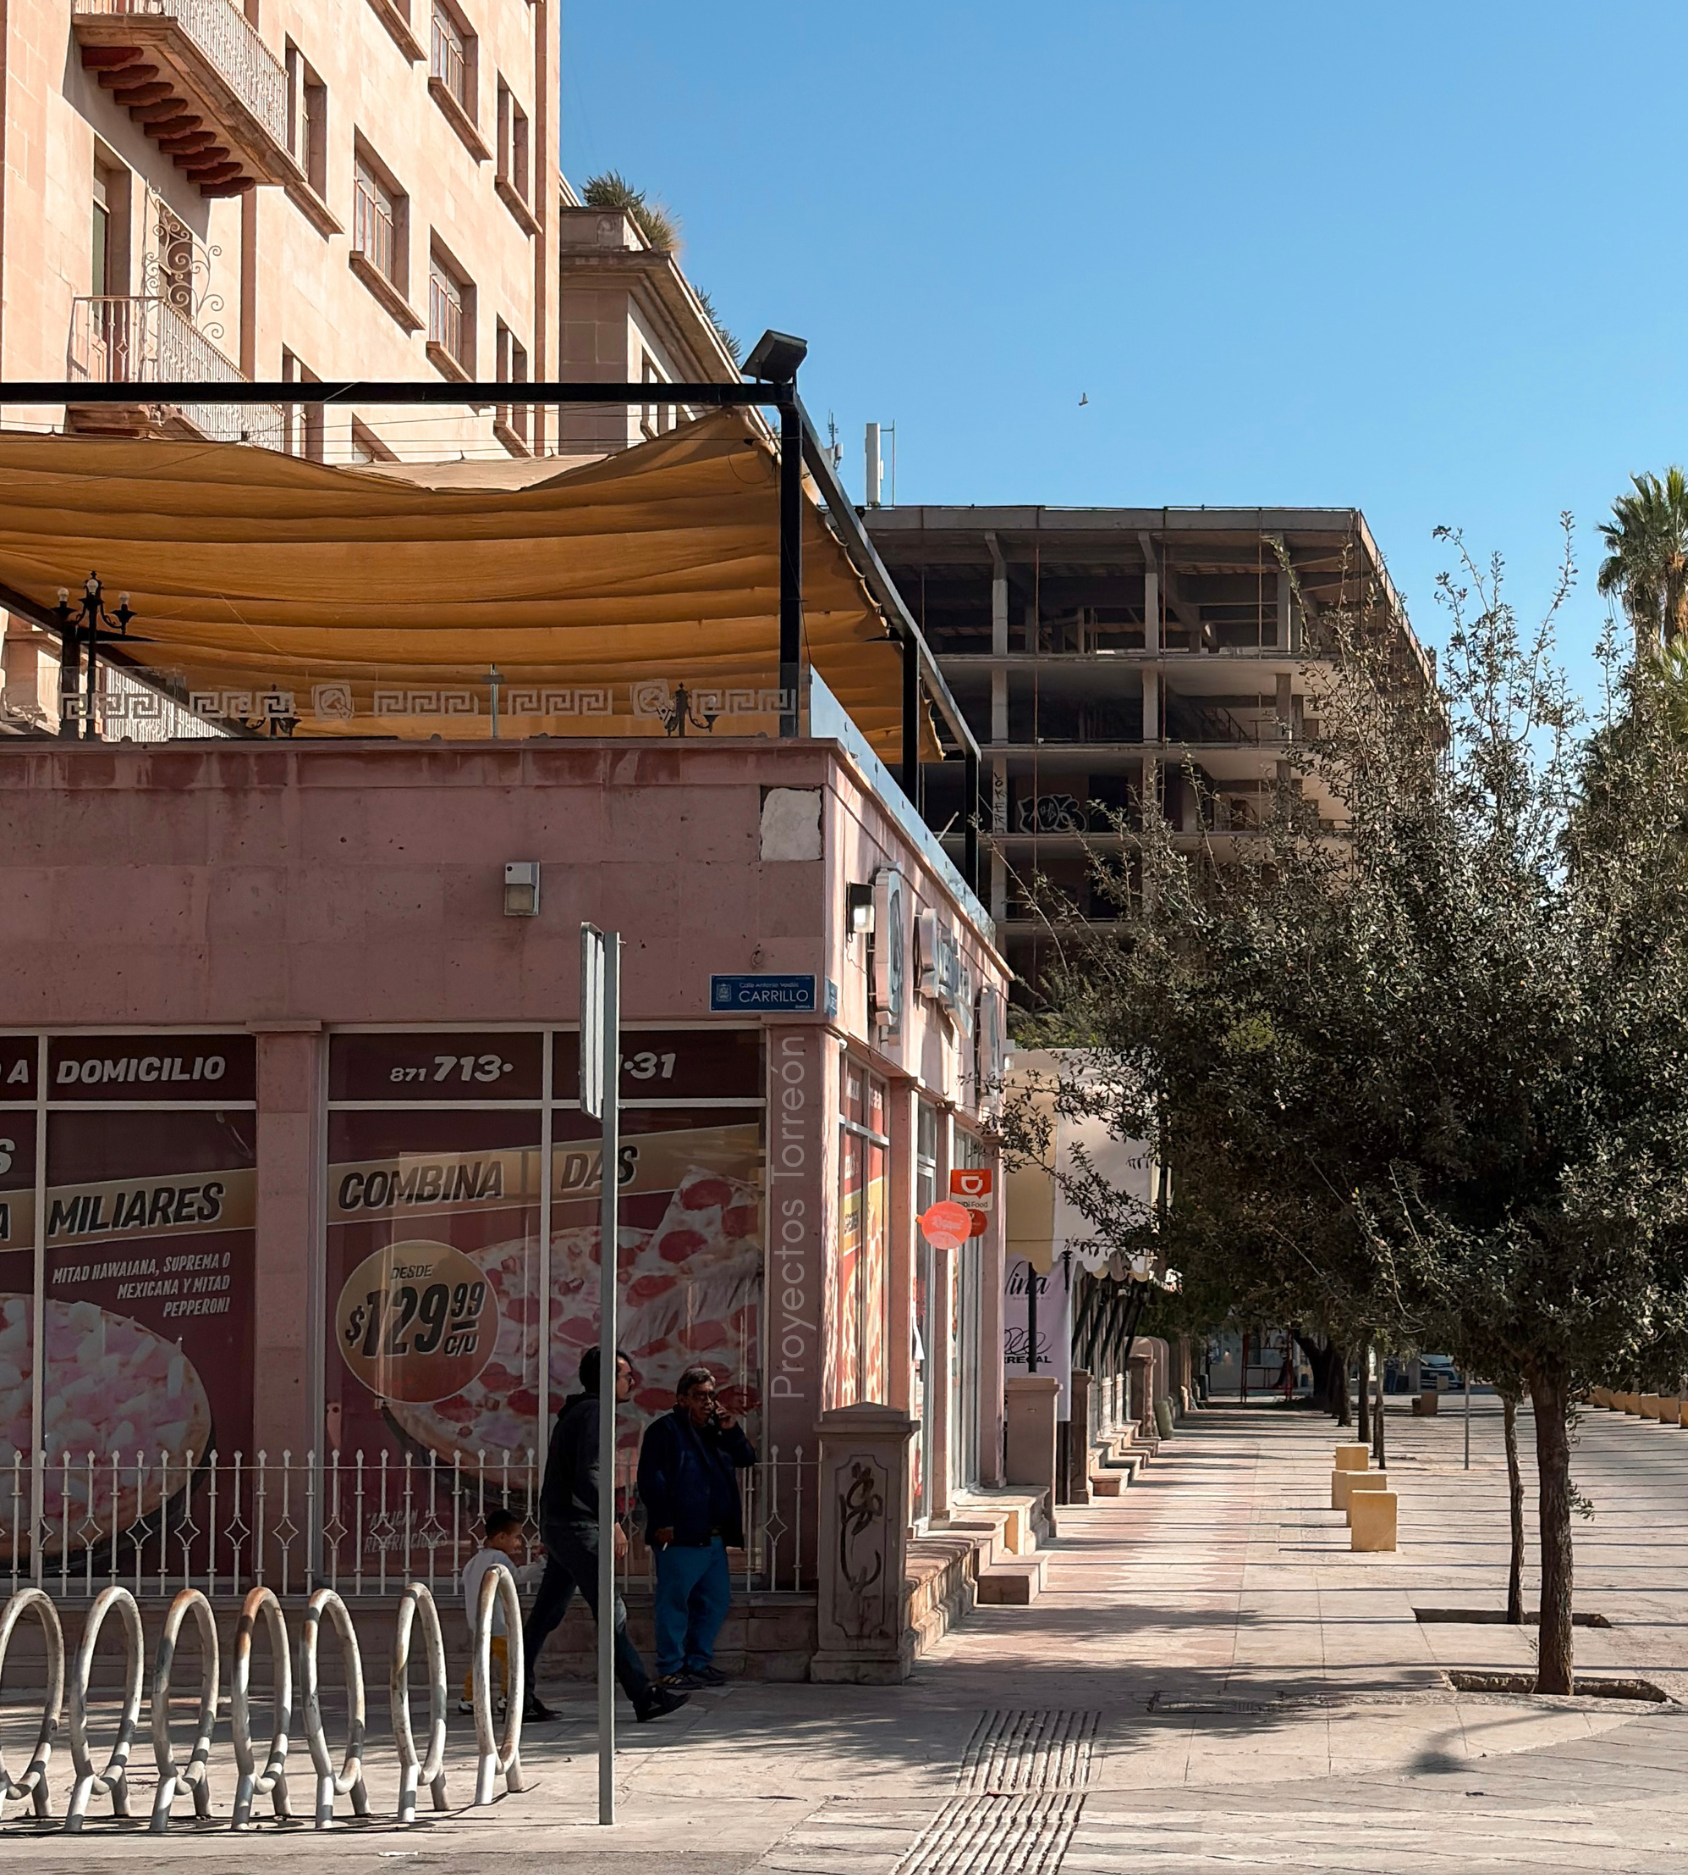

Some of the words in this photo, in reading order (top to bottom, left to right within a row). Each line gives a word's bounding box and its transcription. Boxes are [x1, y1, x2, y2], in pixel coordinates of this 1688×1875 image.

[739, 990, 809, 1003] CARRILLO
[56, 1056, 226, 1084] DOMICILIO
[390, 1067, 427, 1082] 871
[338, 1160, 505, 1212] COMBINA
[52, 1267, 89, 1285] MITAD
[91, 1259, 160, 1280] HAWAIANA,
[163, 1252, 219, 1273] SUPREMA
[222, 1251, 231, 1269] O
[391, 1264, 433, 1281] DESDE
[117, 1278, 179, 1300] MEXICANA
[183, 1277, 193, 1294] Y
[192, 1274, 230, 1293] MITAD
[163, 1296, 231, 1318] PEPPERONI
[444, 1334, 479, 1357] C/U
